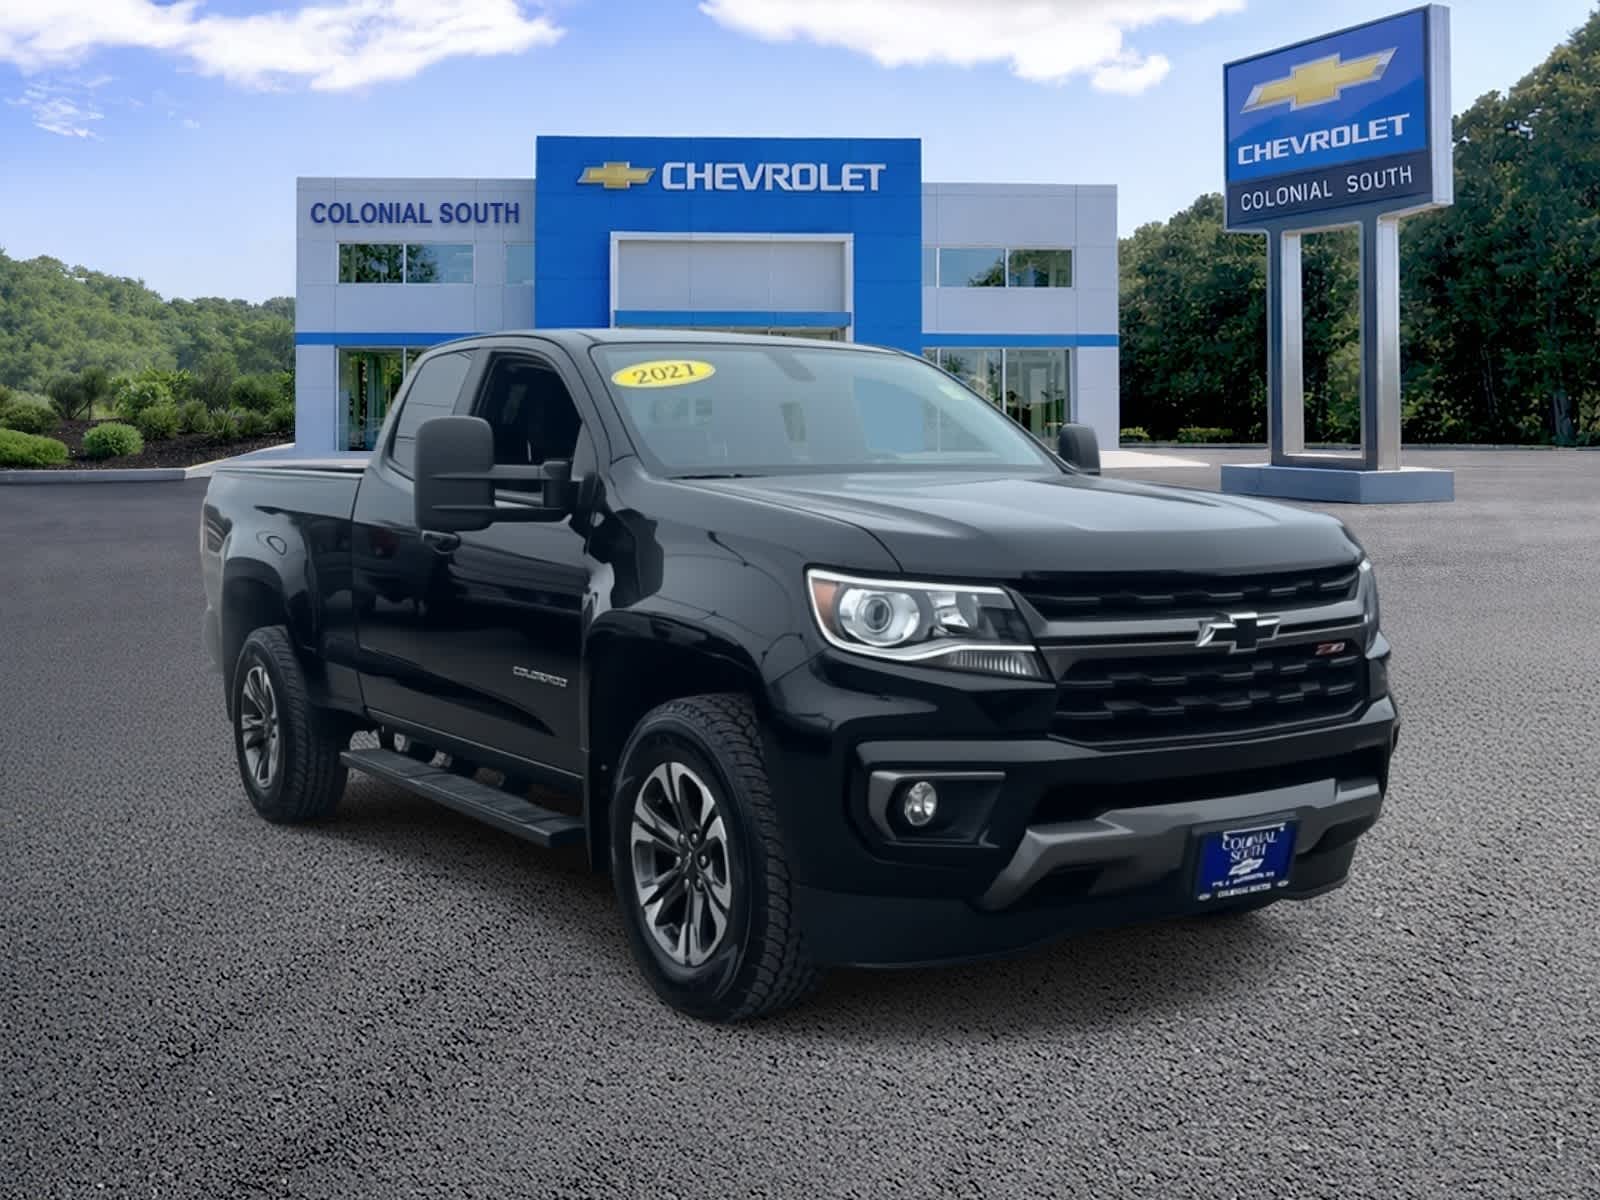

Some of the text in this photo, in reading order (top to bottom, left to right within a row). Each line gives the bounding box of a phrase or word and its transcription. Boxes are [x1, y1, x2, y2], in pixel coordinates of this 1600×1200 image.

[1238, 113, 1410, 165] CHEVROLET
[662, 161, 887, 192] CHEVROLET
[1240, 165, 1413, 212] COLONIAL SOUTH
[310, 202, 520, 225] COLONIAL SOUTH
[632, 363, 695, 385] 2021
